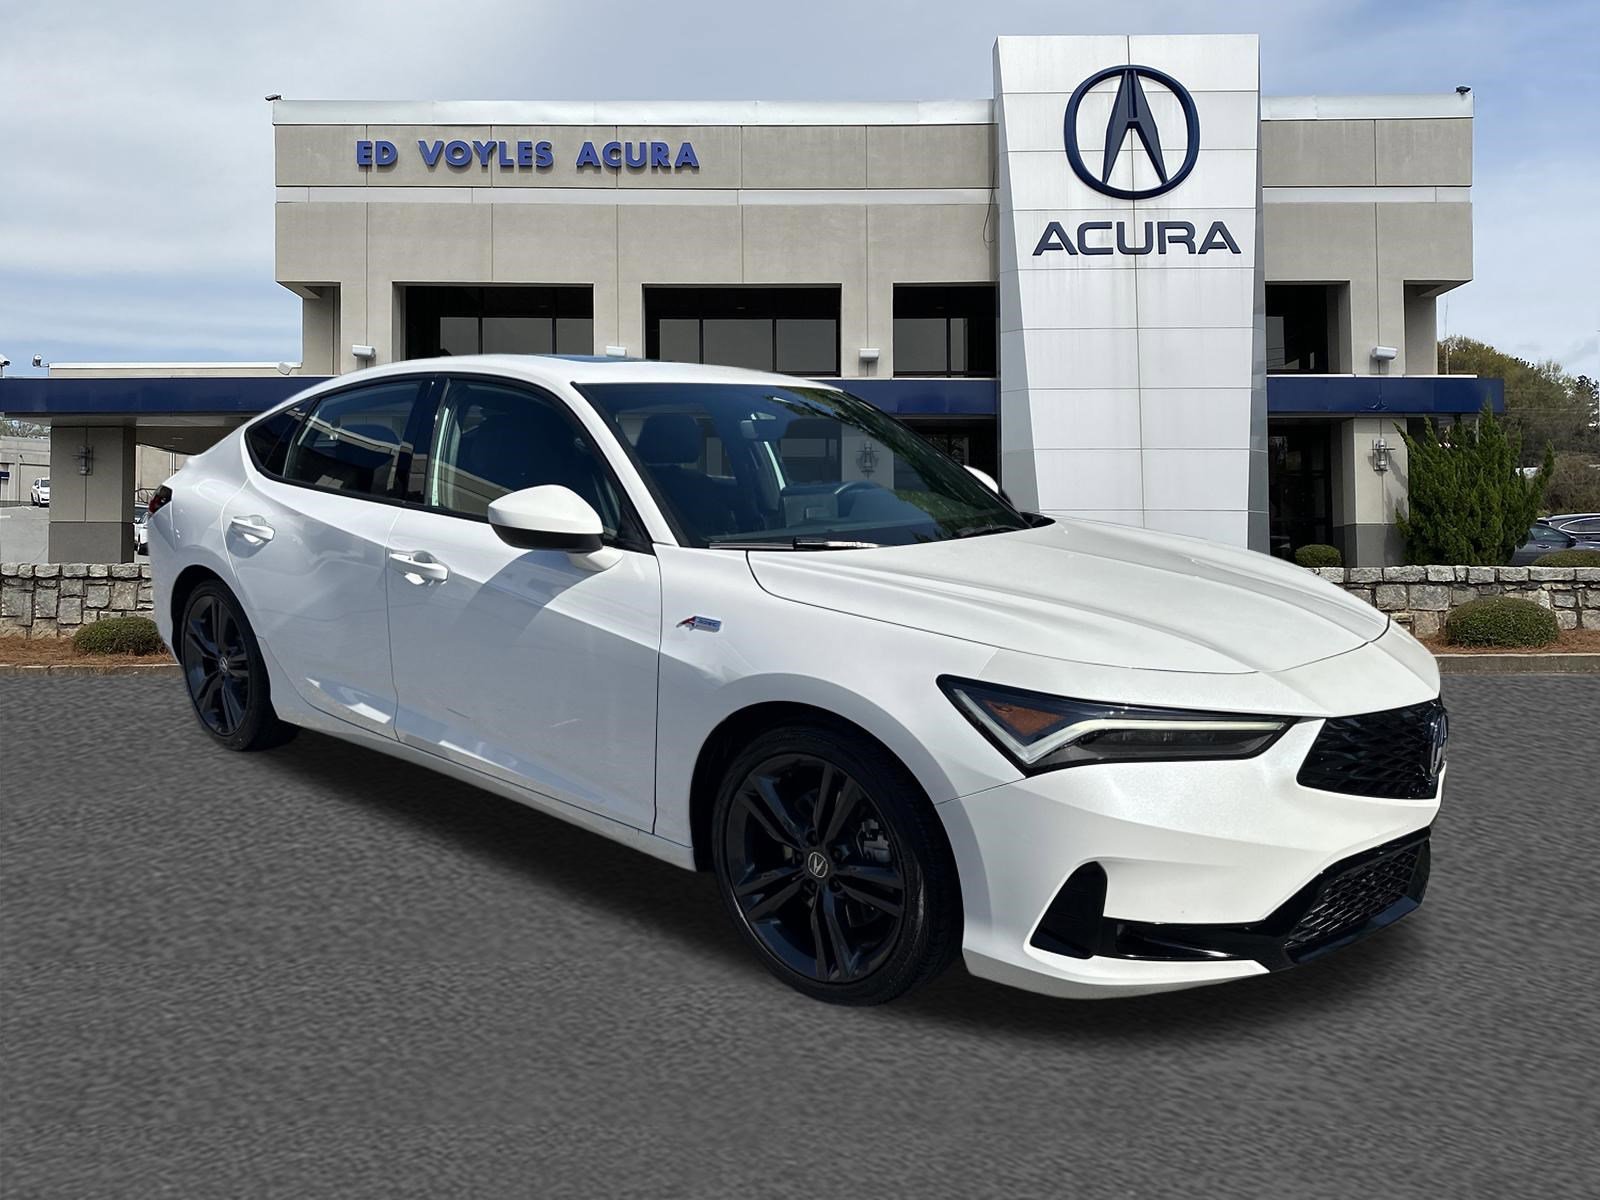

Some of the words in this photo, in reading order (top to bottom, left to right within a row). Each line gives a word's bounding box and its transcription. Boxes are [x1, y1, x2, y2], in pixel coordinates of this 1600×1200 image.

[356, 140, 398, 167] ED
[418, 140, 554, 167] VOYLES
[576, 141, 700, 168] ACURA
[1032, 221, 1242, 256] ACURA
